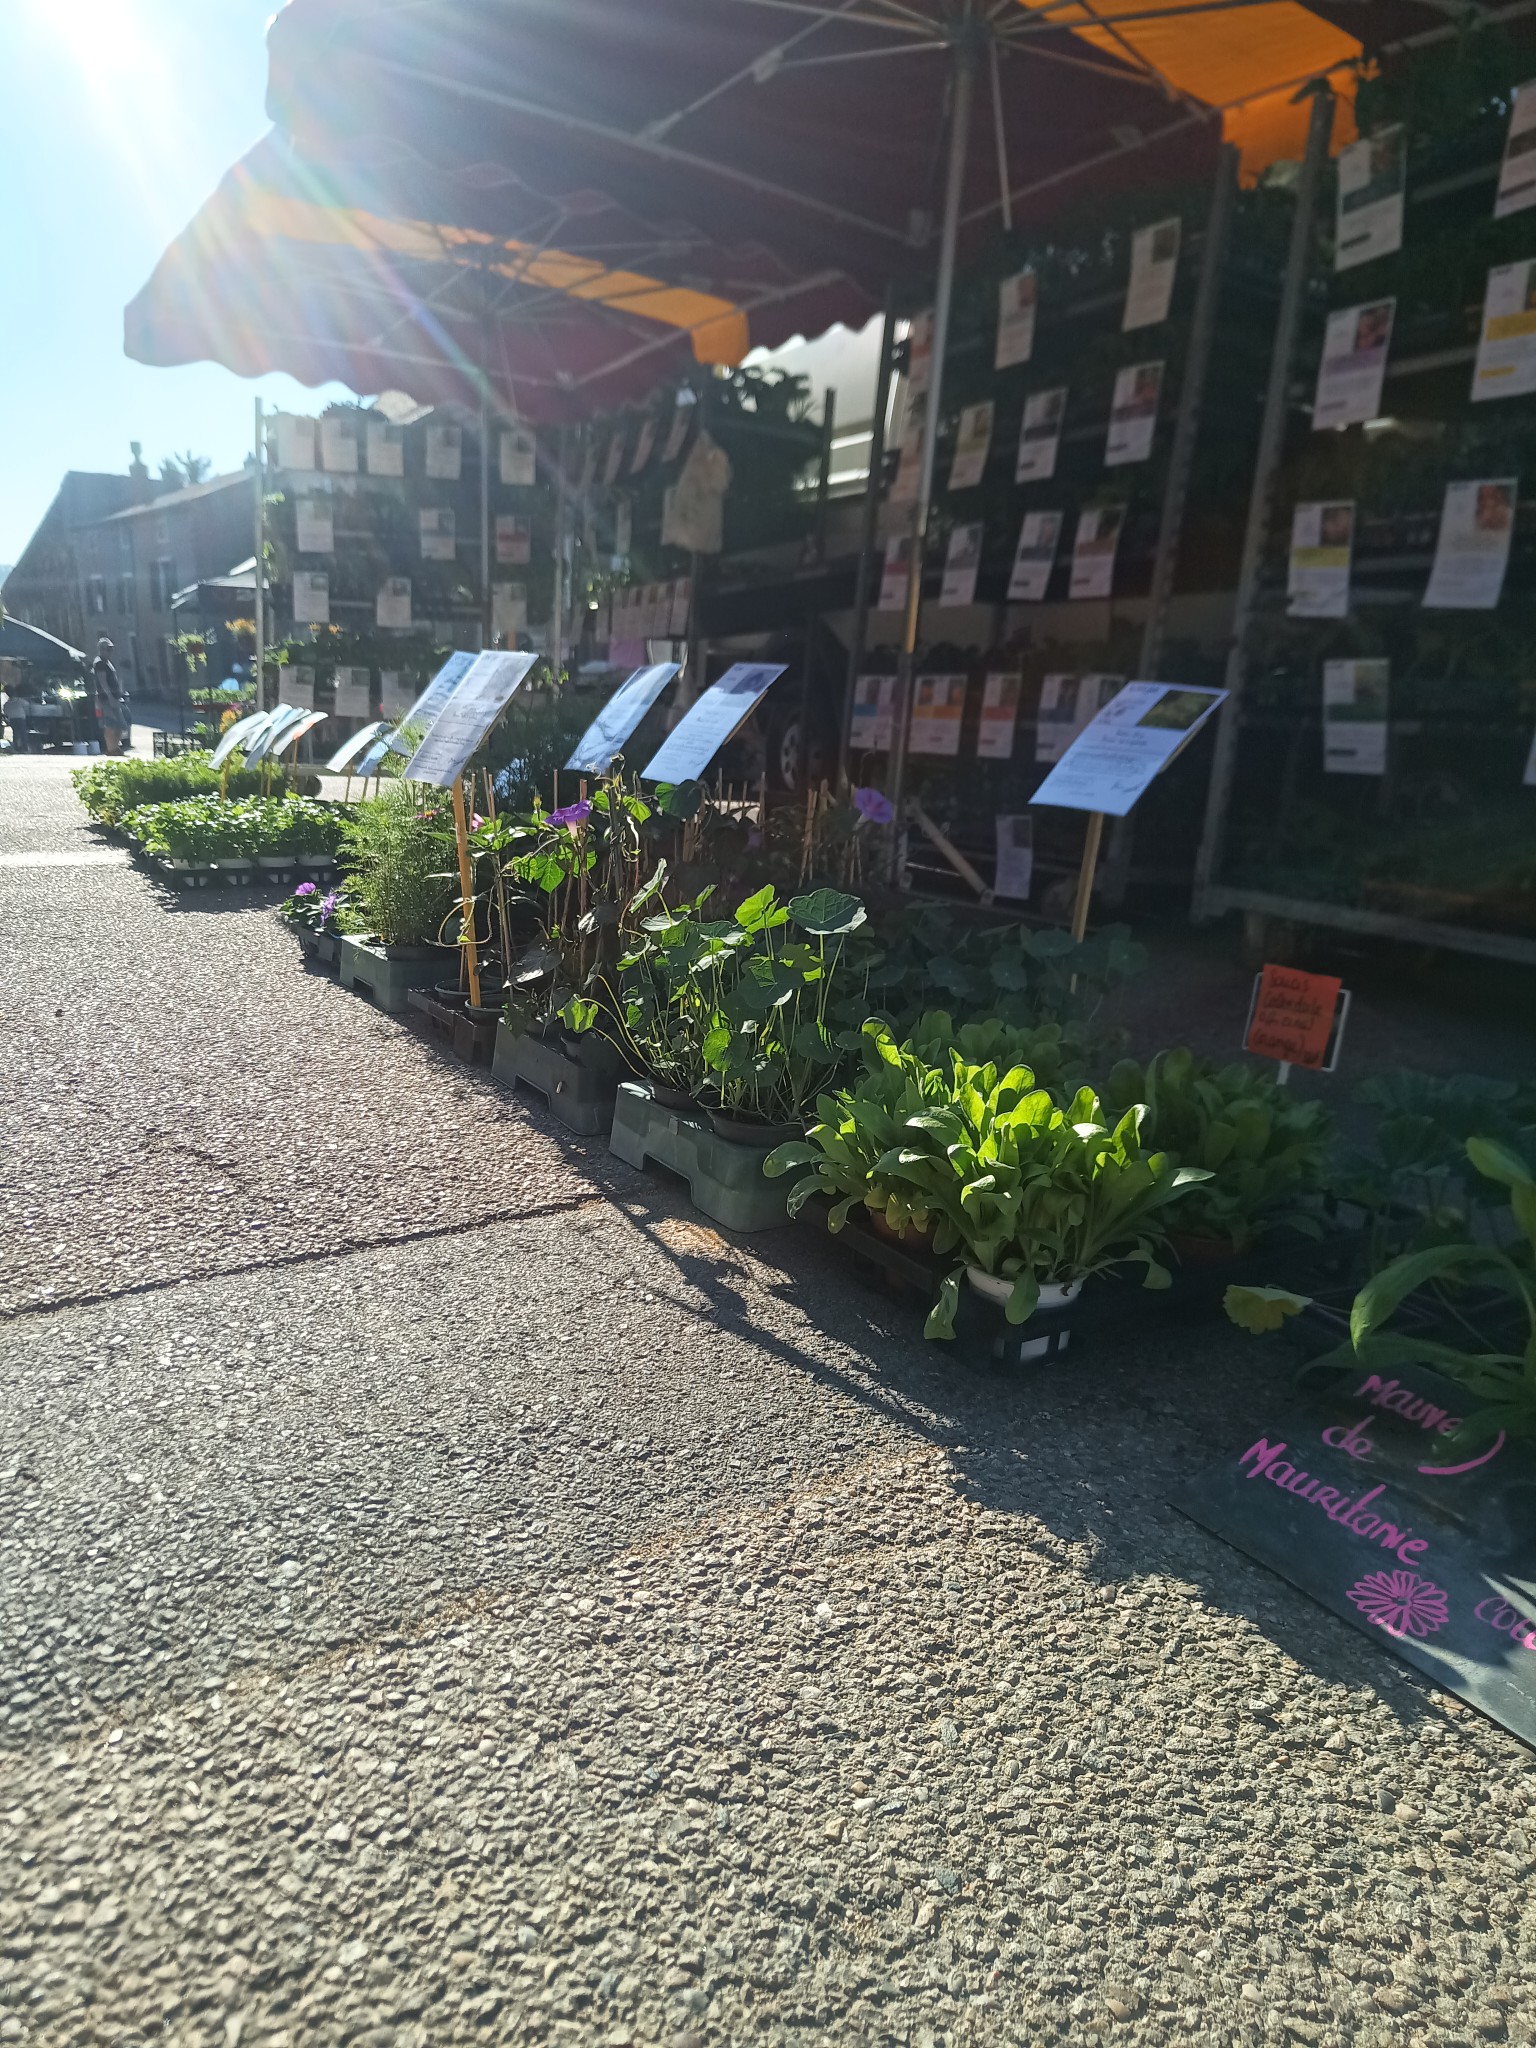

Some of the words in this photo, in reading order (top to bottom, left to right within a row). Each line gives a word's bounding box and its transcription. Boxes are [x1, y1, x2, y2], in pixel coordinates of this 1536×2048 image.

[1353, 1375, 1464, 1434] Mauve
[1321, 1415, 1376, 1463] de
[1239, 1437, 1429, 1566] Mauritanie
